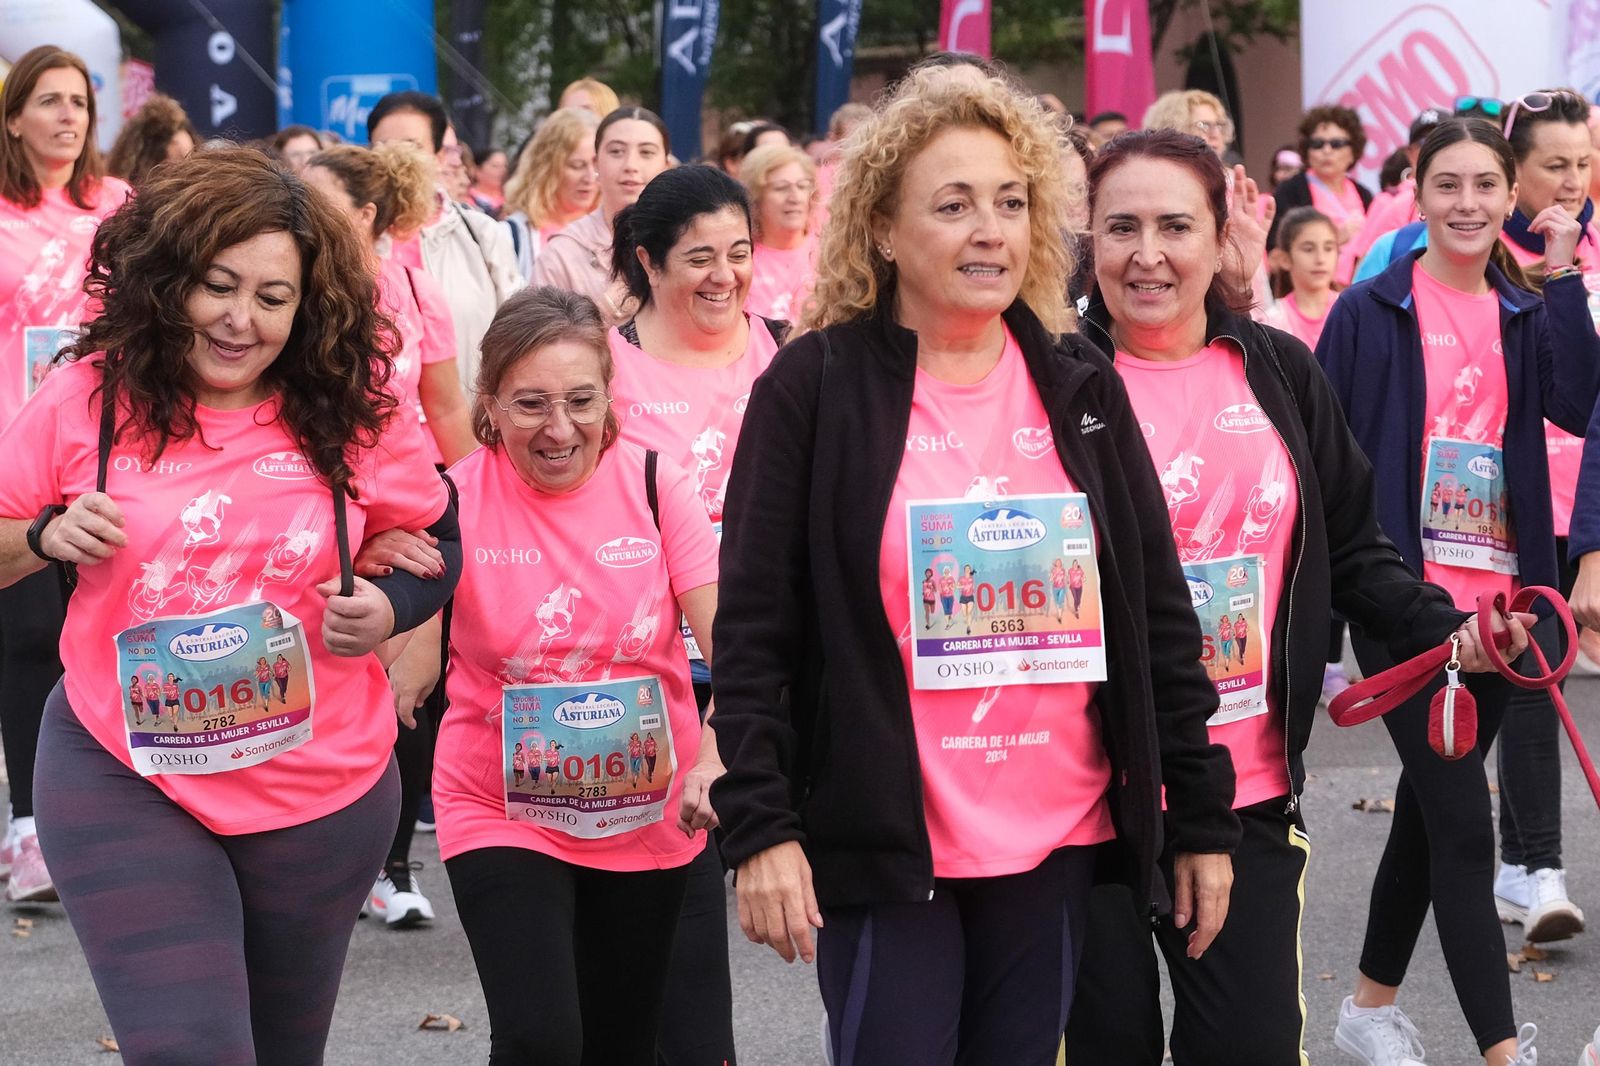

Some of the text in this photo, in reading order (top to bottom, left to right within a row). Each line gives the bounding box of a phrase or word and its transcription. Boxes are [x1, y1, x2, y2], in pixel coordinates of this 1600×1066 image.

[629, 401, 689, 417] OYSHO
[1065, 506, 1080, 520] 20
[921, 521, 953, 531] SUMA
[973, 525, 1041, 542] ASTURIANA
[1438, 531, 1467, 541] CARRERA
[1467, 535, 1477, 543] DE
[1477, 536, 1486, 544] LA
[476, 547, 541, 564] OYSHO
[601, 547, 654, 562] ASTURIANA
[1433, 545, 1474, 560] OYSHO
[1231, 566, 1245, 580] 20
[976, 579, 1047, 612] 016
[991, 618, 1025, 633] 6363
[127, 634, 156, 643] SUMA
[175, 634, 244, 655] ASTURIANA
[943, 633, 1082, 652] CARRERA DE LA MUJER SEVILLA
[937, 658, 1089, 679] OYSHO Santander
[1217, 677, 1247, 691] SEVILLA
[183, 678, 254, 713] 016
[639, 687, 650, 700] 20
[513, 702, 541, 712] SUMA
[559, 707, 621, 721] ASTURIANA
[203, 714, 236, 731] 2782
[153, 716, 290, 745] CARRERA DE LA MUJER SEVILLA
[942, 730, 1050, 750] CARRERA DE LA MUJER
[151, 733, 297, 766] OYSHO Santander
[563, 751, 626, 781] 016
[578, 786, 607, 798] 2783
[530, 794, 651, 809] CARRERA DE LA MUJER SEVILLA
[525, 807, 650, 827] OYSHO Santander
